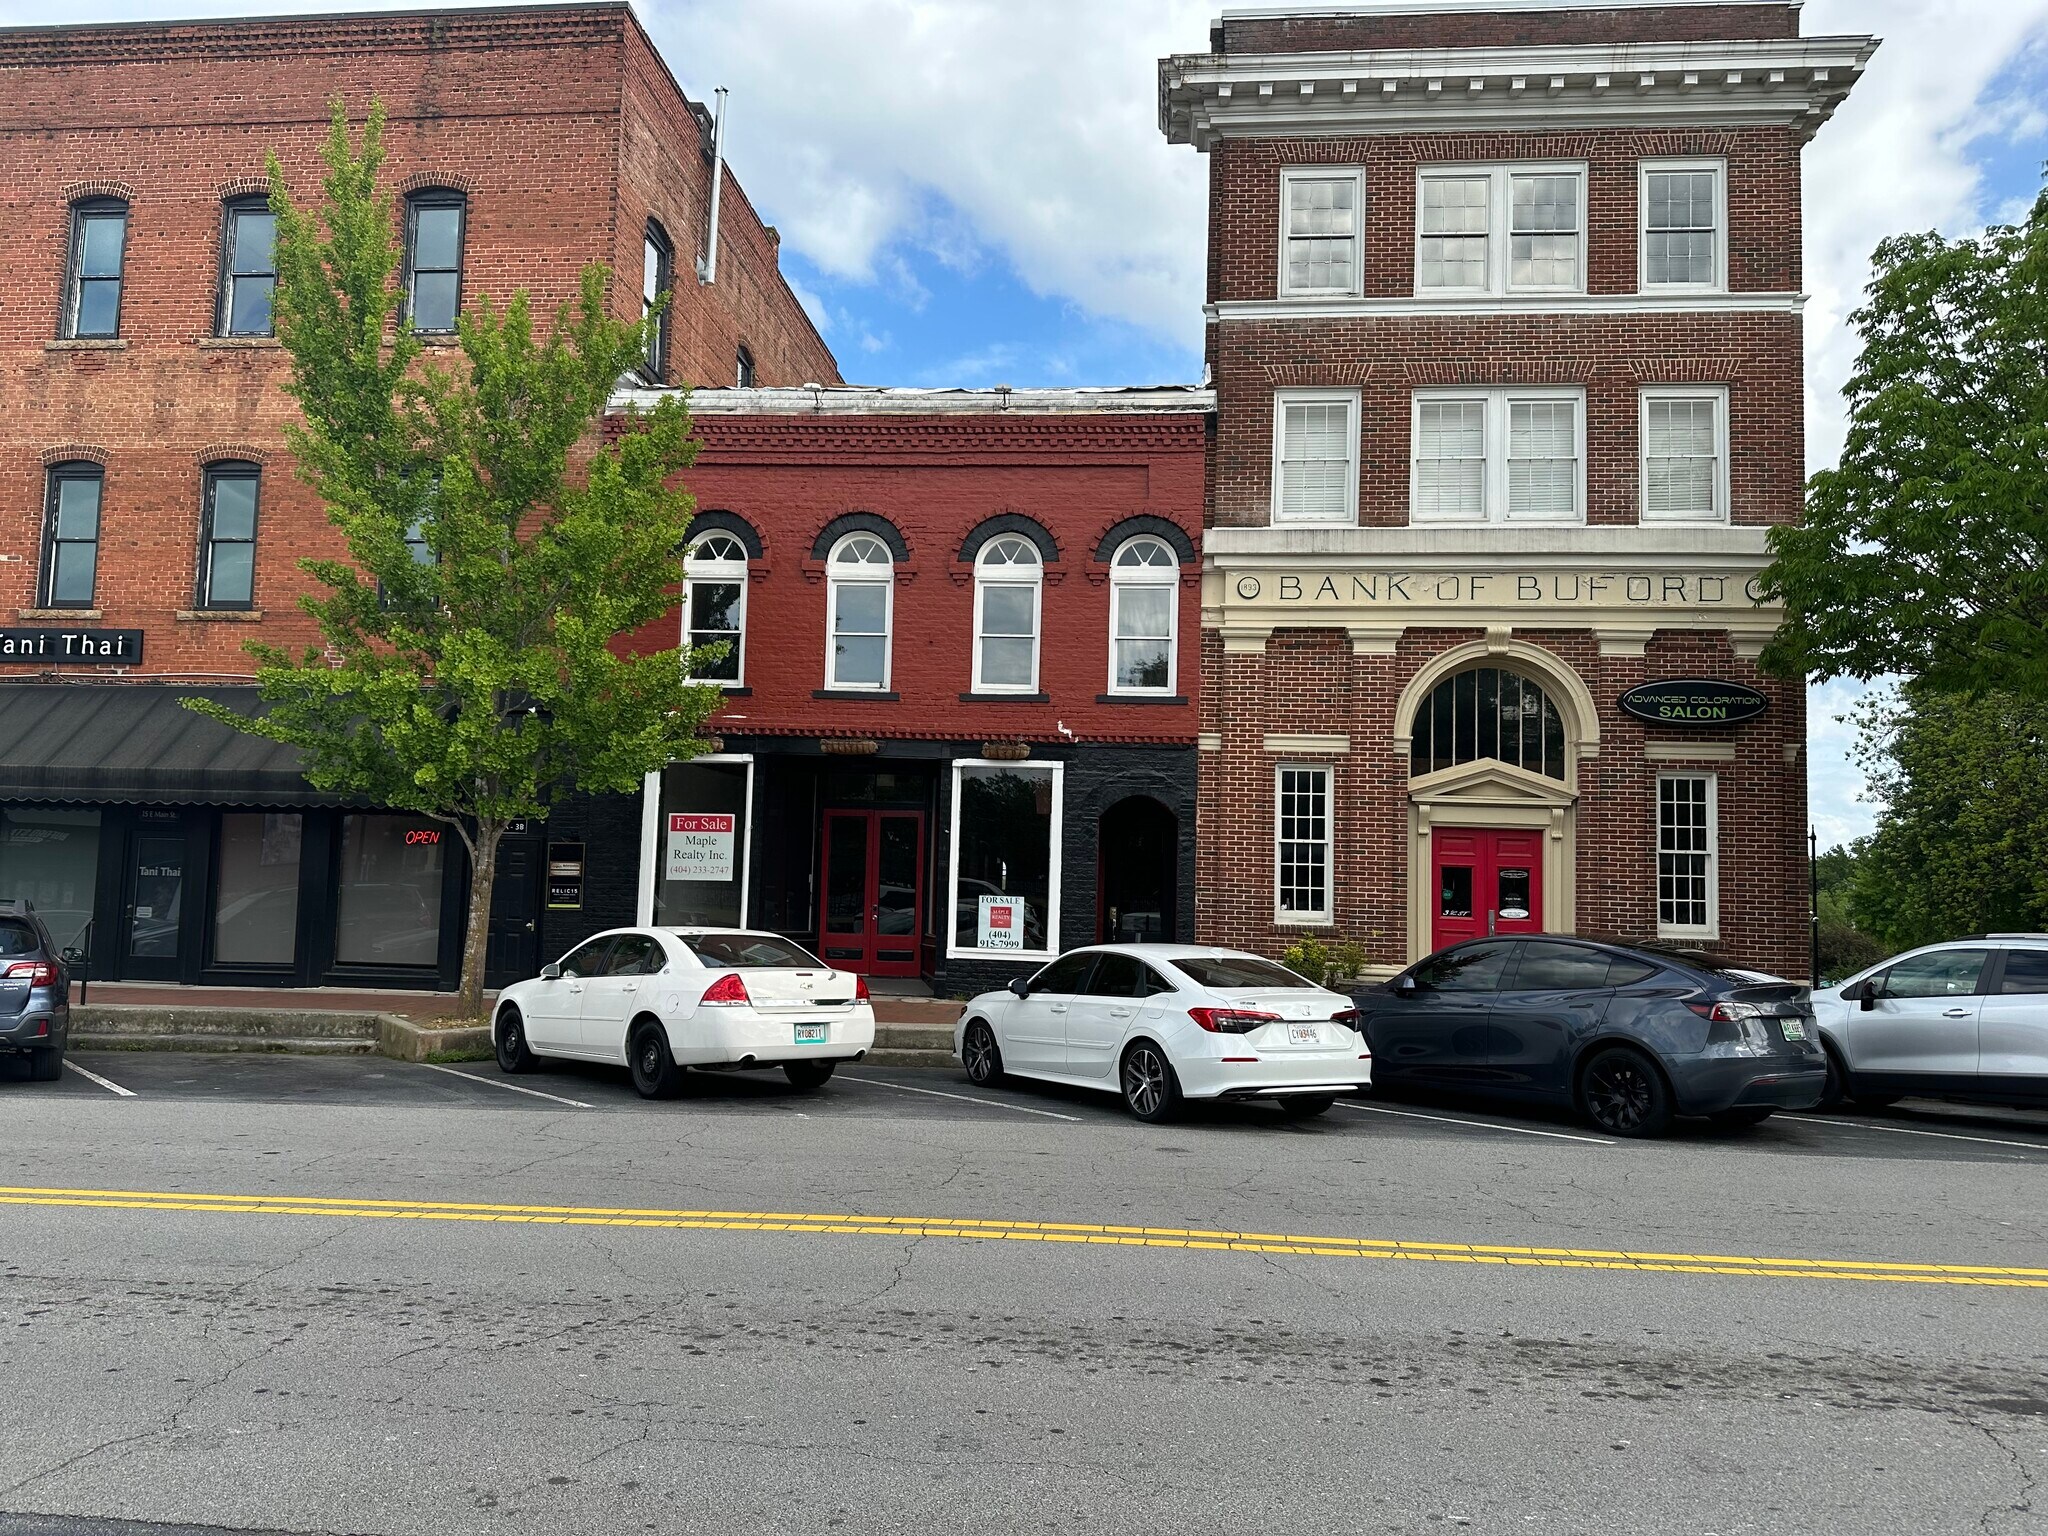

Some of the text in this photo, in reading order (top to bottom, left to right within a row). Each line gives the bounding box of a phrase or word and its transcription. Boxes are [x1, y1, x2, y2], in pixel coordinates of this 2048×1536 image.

[1279, 576, 1725, 602] BANK OF BUFORD
[0, 633, 123, 655] ani Thai
[1627, 695, 1761, 705] ADVANCED COLORATION
[1659, 706, 1727, 719] SALON
[676, 817, 727, 830] For Sale
[405, 830, 440, 845] OPEN
[685, 835, 718, 848] Maple
[673, 849, 728, 863] Realty Inc.
[139, 866, 182, 877] Tani Thai
[670, 865, 729, 875] (404) 233-2747
[981, 896, 1021, 905] FOR SALE
[988, 930, 1011, 940] (404)
[979, 939, 1020, 949] 915-7999
